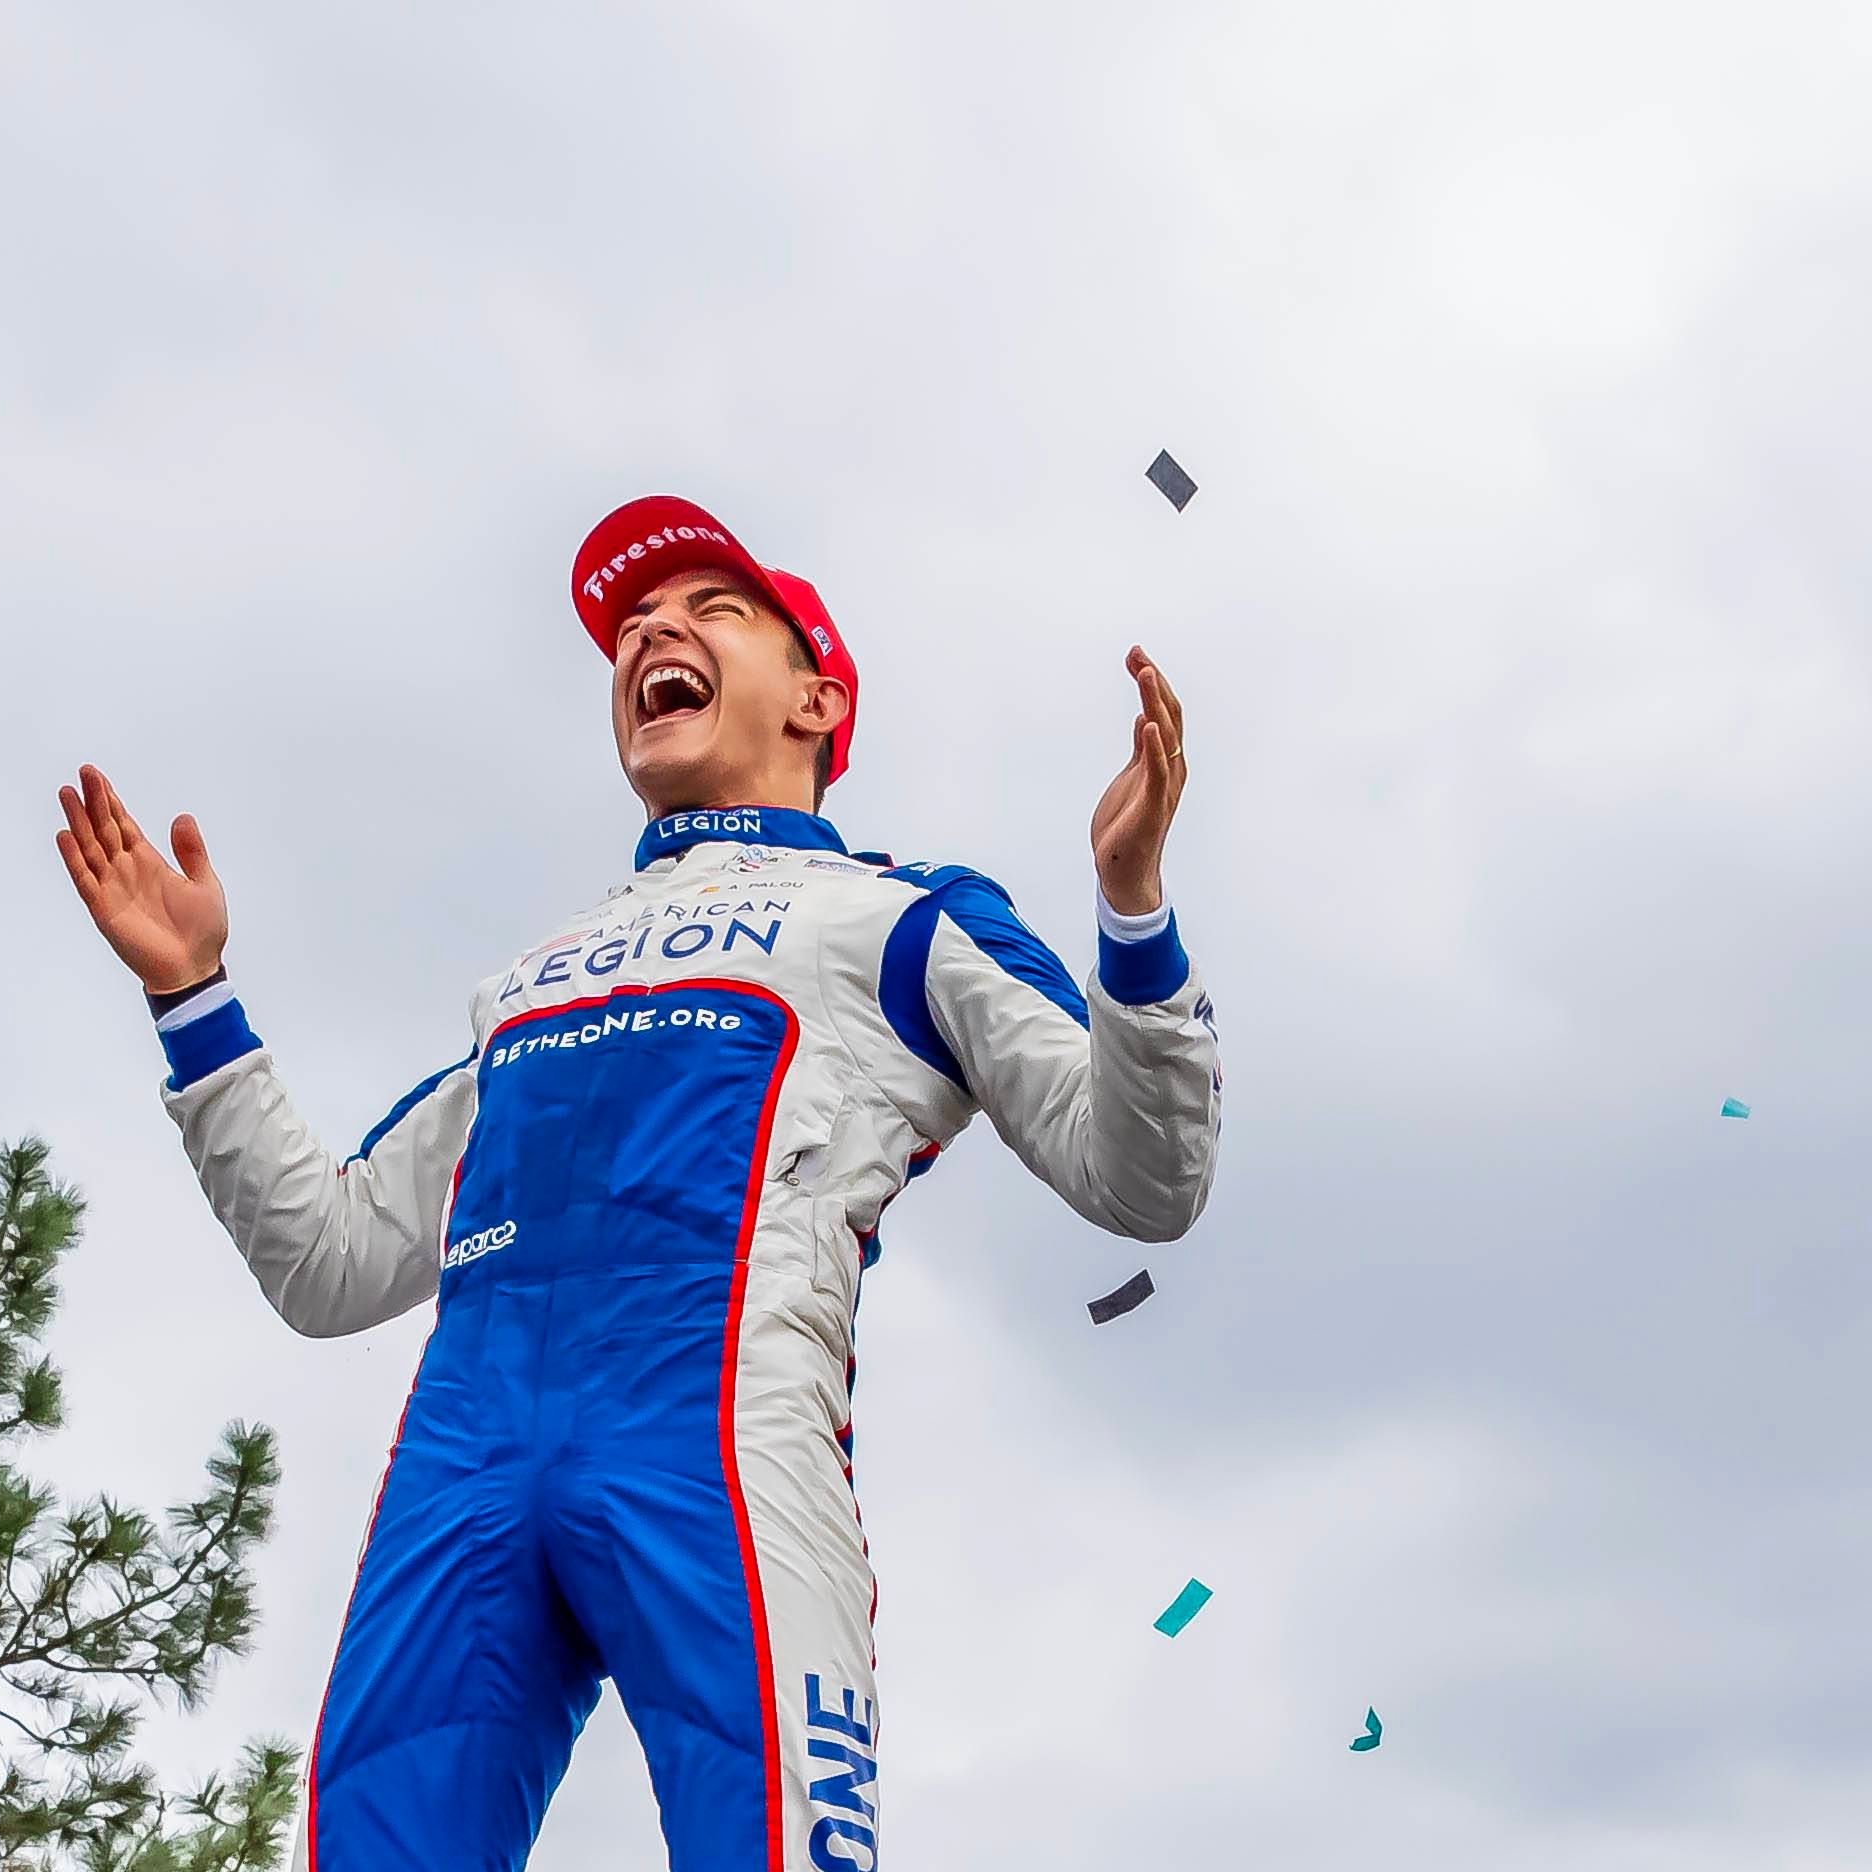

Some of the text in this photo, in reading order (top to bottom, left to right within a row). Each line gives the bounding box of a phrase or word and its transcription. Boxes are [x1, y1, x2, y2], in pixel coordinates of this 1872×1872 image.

[583, 526, 729, 602] Firestone
[659, 813, 761, 839] LEGION
[585, 900, 791, 942] AMERICAN
[499, 916, 783, 1003] LEGION
[491, 1007, 742, 1070] BETHEONE.ORG
[445, 1220, 517, 1269] sparco
